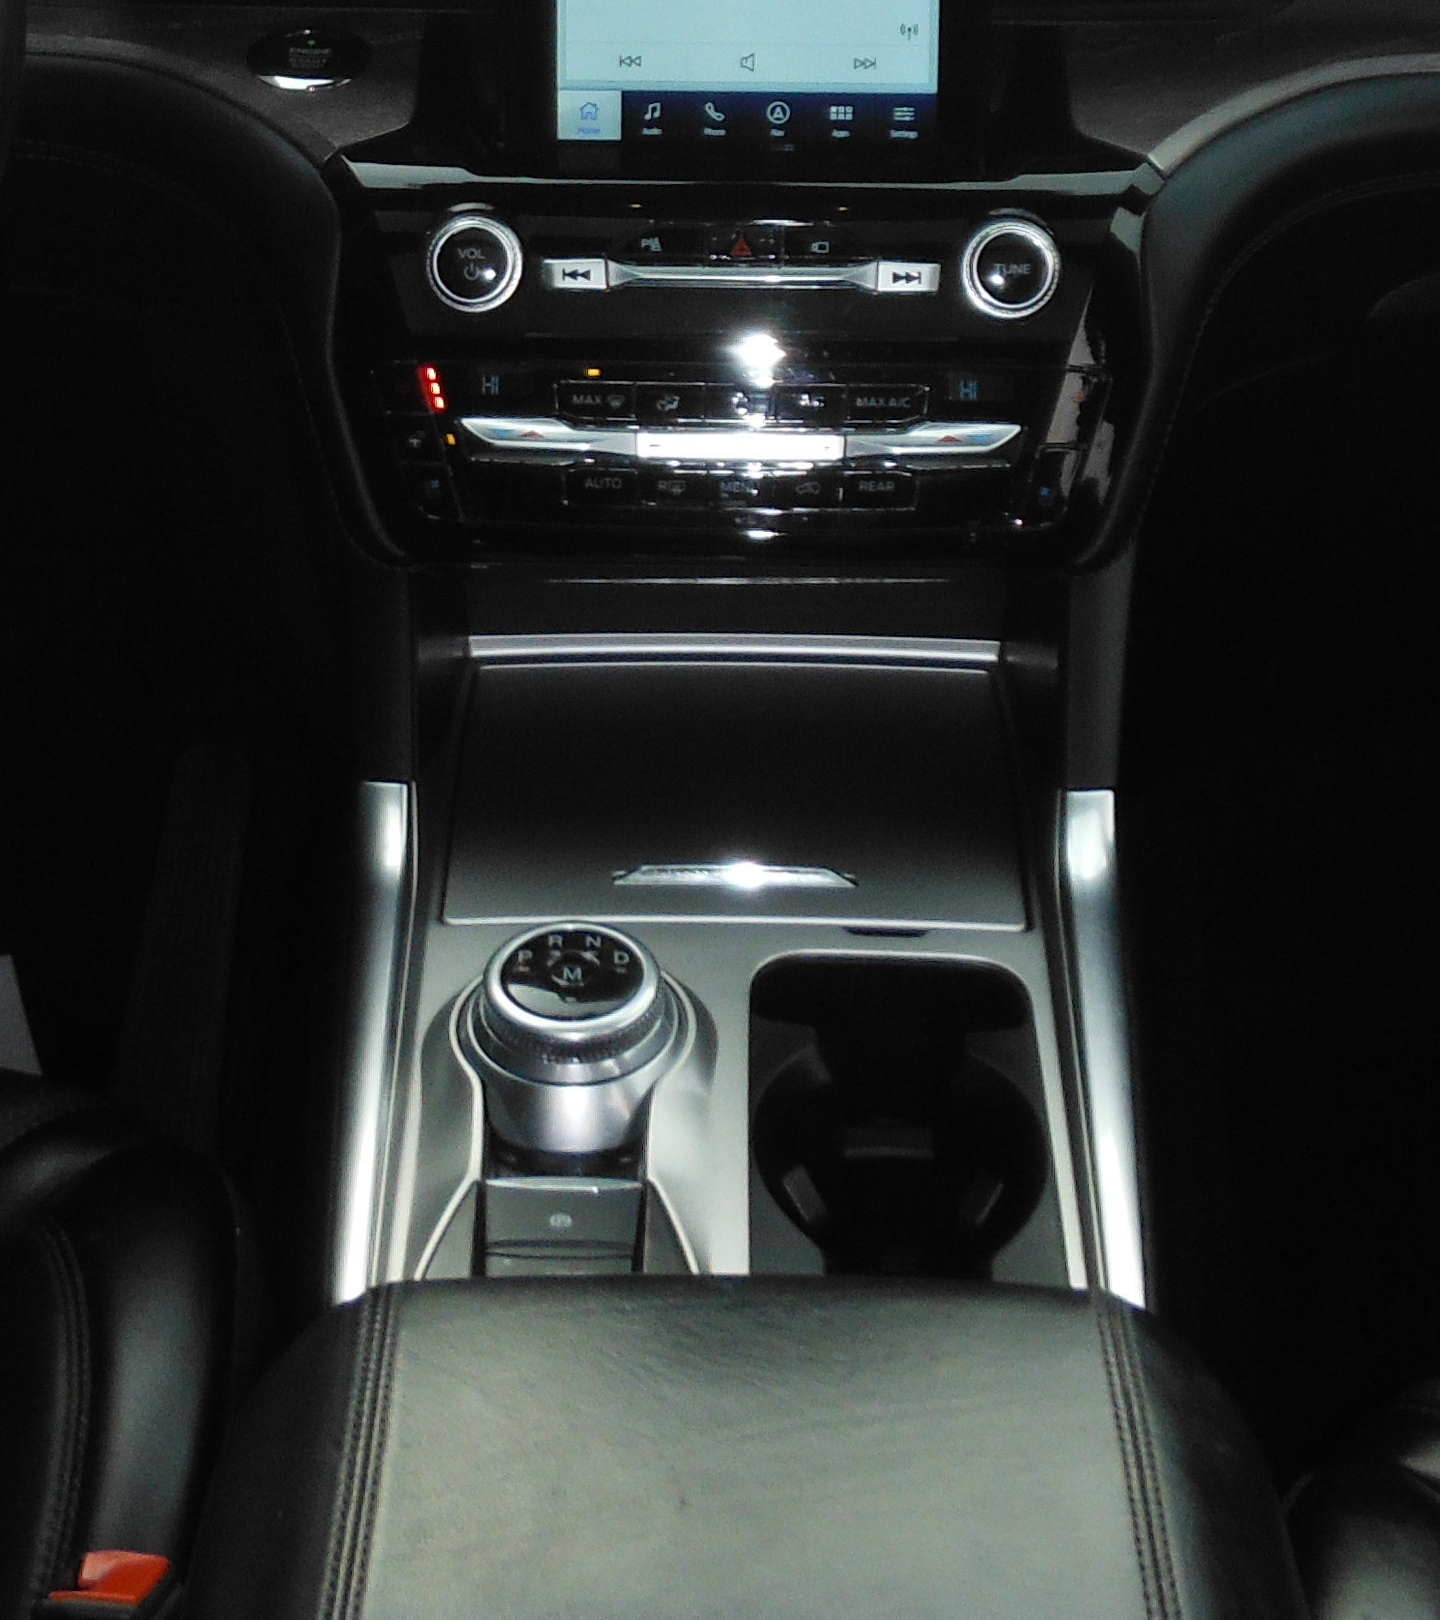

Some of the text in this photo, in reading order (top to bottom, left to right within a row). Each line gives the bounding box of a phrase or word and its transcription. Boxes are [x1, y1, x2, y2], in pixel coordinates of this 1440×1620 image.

[457, 247, 486, 260] VOL
[993, 263, 1032, 276] TUNE
[481, 375, 500, 396] HI
[572, 394, 603, 406] MAX
[856, 397, 912, 409] MAX A/C
[584, 477, 623, 490] AUTO
[858, 481, 896, 493] REAR
[547, 934, 563, 947] R
[585, 935, 602, 948] N
[516, 949, 534, 964] P
[613, 951, 631, 965] D
[562, 966, 583, 981] M
